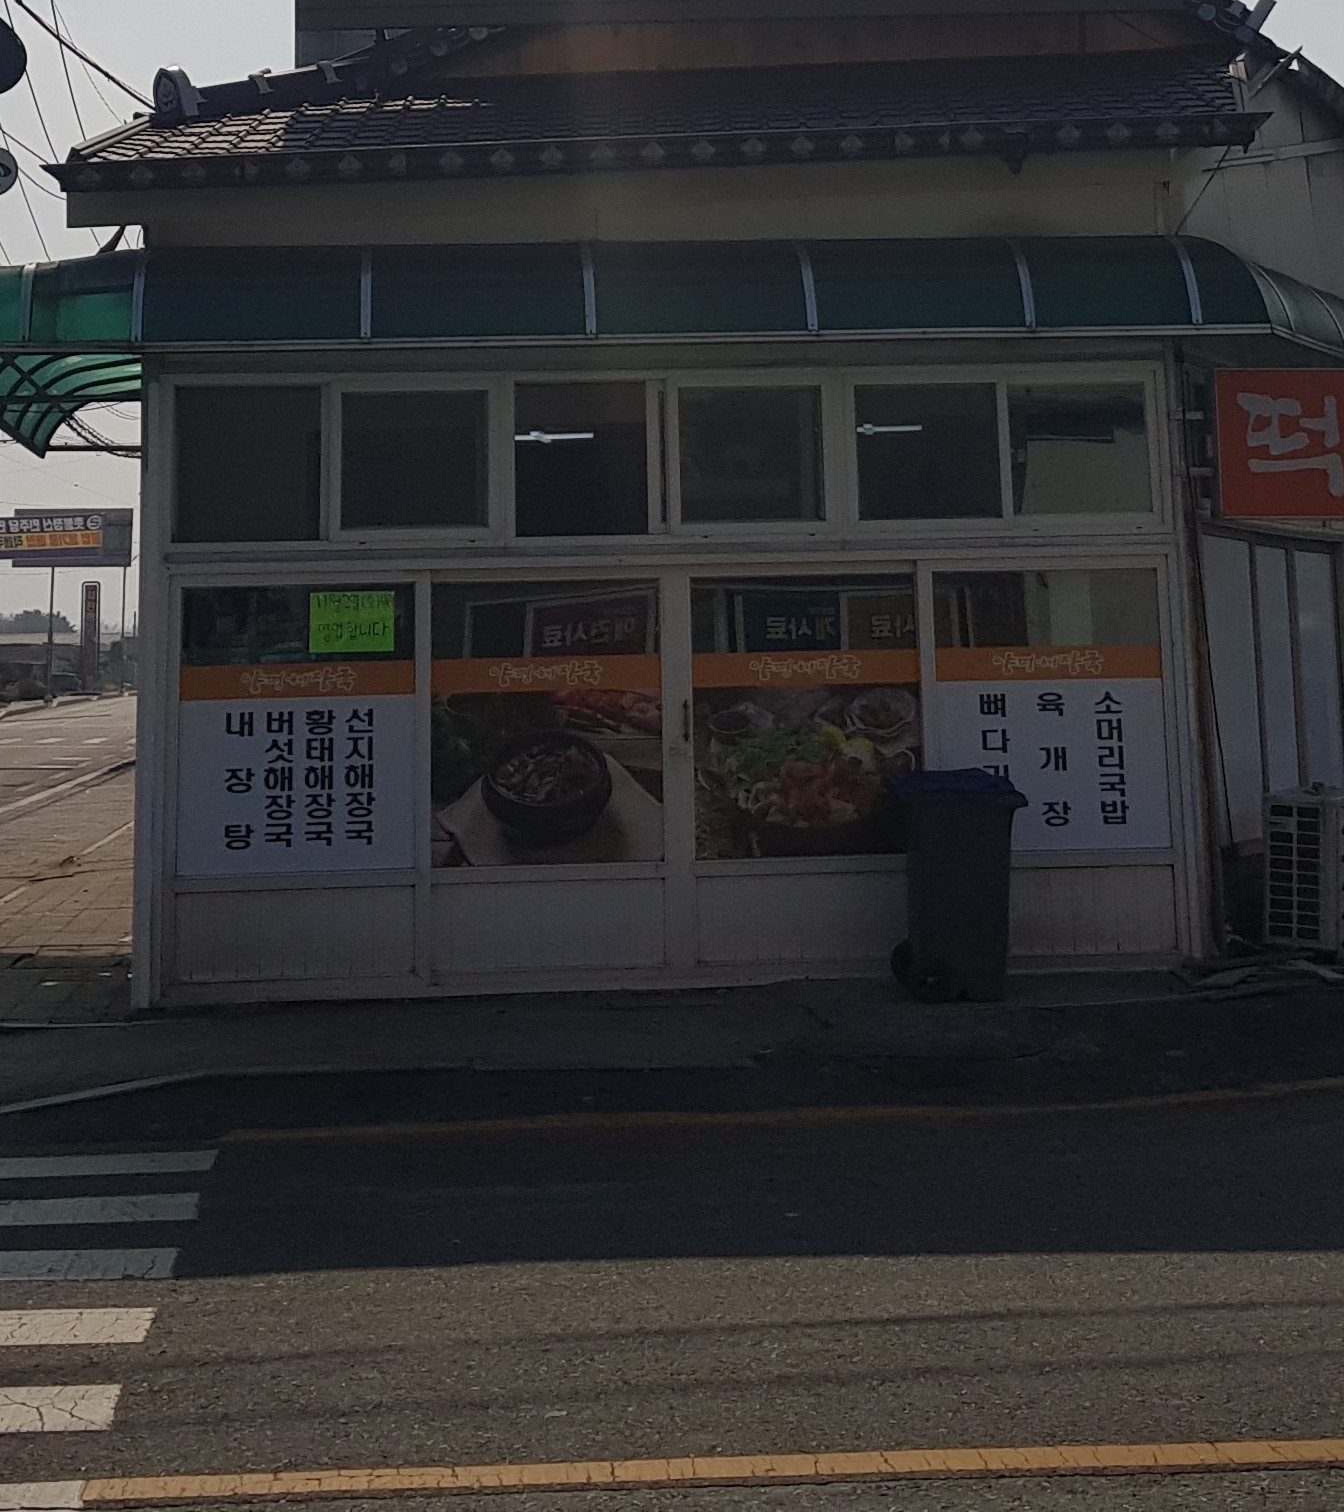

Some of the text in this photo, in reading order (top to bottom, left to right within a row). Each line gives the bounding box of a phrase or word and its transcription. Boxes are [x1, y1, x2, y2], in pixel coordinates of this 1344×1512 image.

[224, 710, 255, 851] 내장탕
[263, 710, 296, 848] 버섯해장국
[304, 709, 337, 847] 황태해장국
[344, 708, 376, 845] 선지해장국
[1036, 691, 1071, 827] 육개장
[1094, 691, 1130, 825] 소머리국밥
